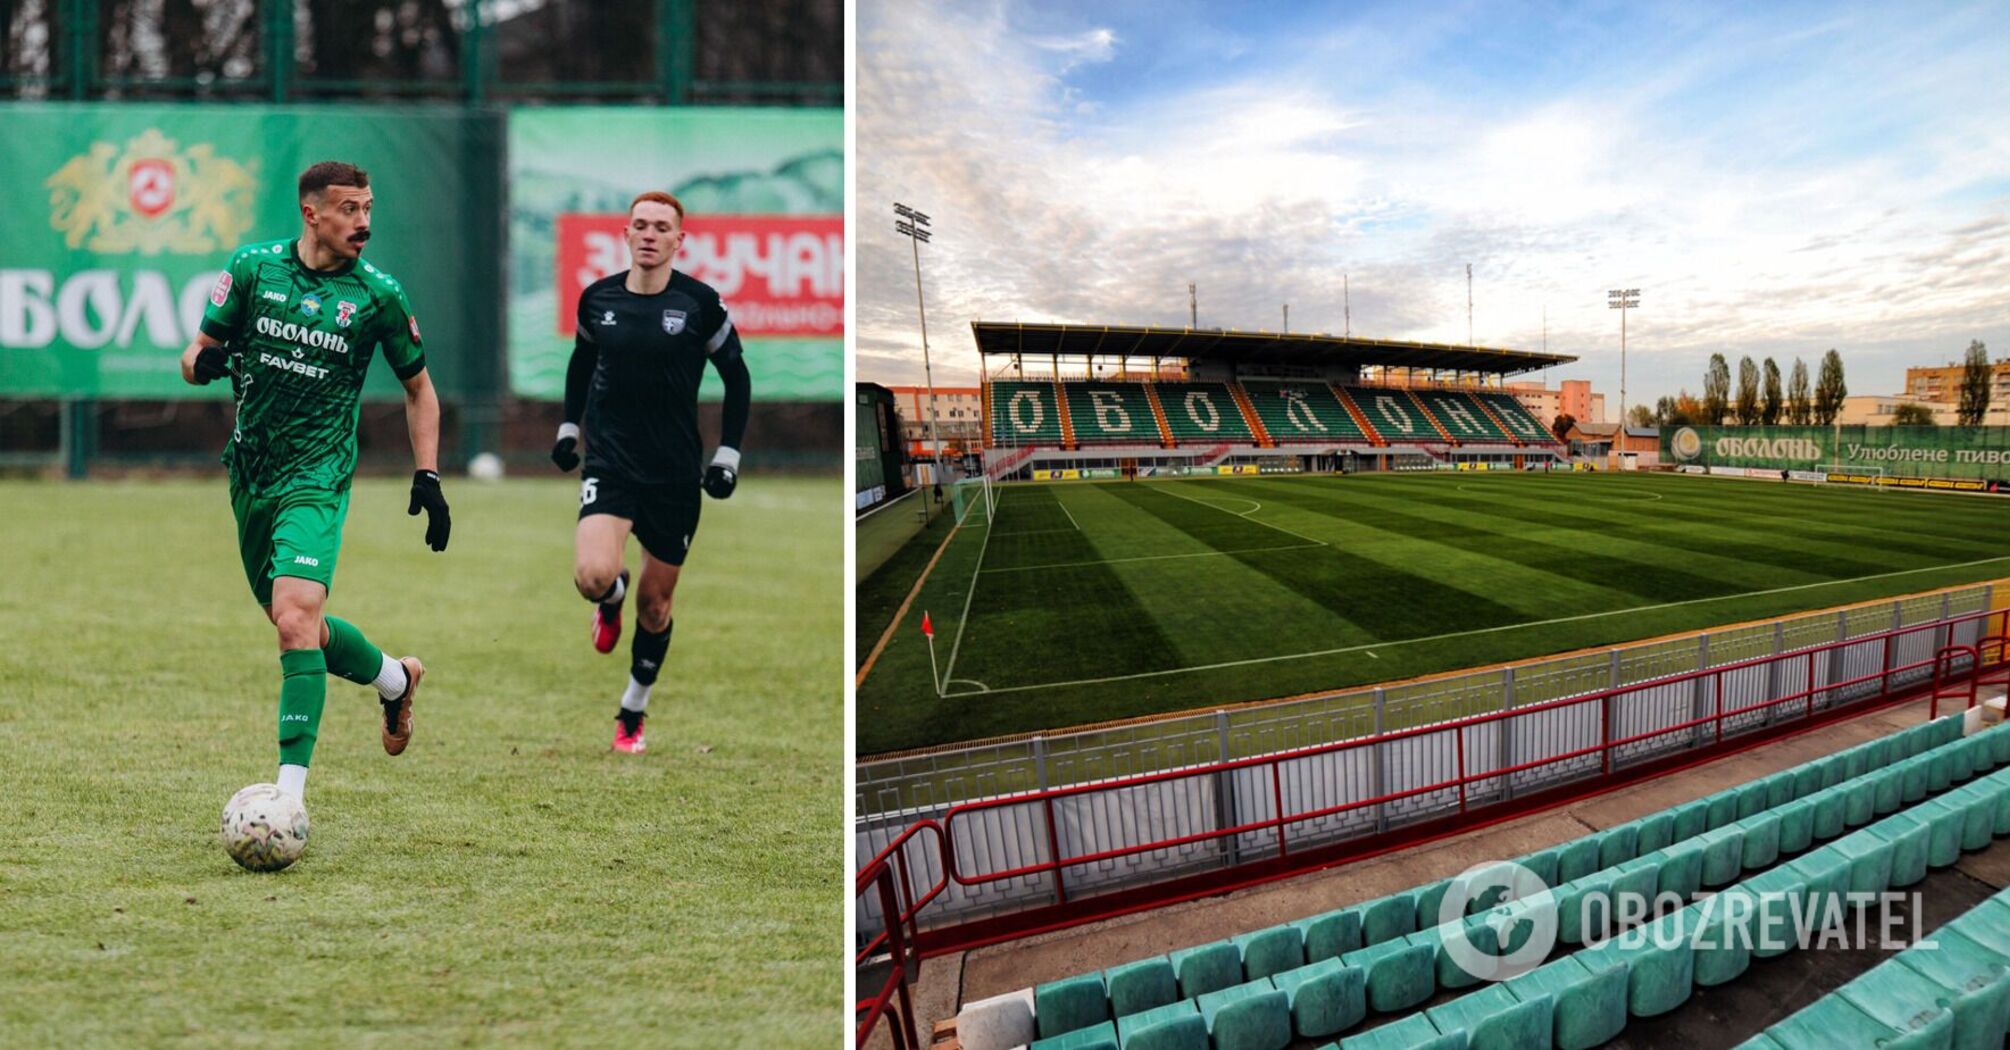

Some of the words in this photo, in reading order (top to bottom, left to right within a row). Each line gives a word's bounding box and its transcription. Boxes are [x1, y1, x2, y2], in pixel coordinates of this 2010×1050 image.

[262, 290, 287, 302] JAKO
[256, 316, 349, 354] ОБОЛОНЬ
[259, 353, 330, 380] FAVBET
[1715, 437, 1821, 461] ОБОЛОНЬ
[1847, 443, 1948, 462] Улюблене
[1955, 449, 2010, 465] пиво
[294, 555, 319, 567] JAKO
[280, 713, 309, 722] JAKO
